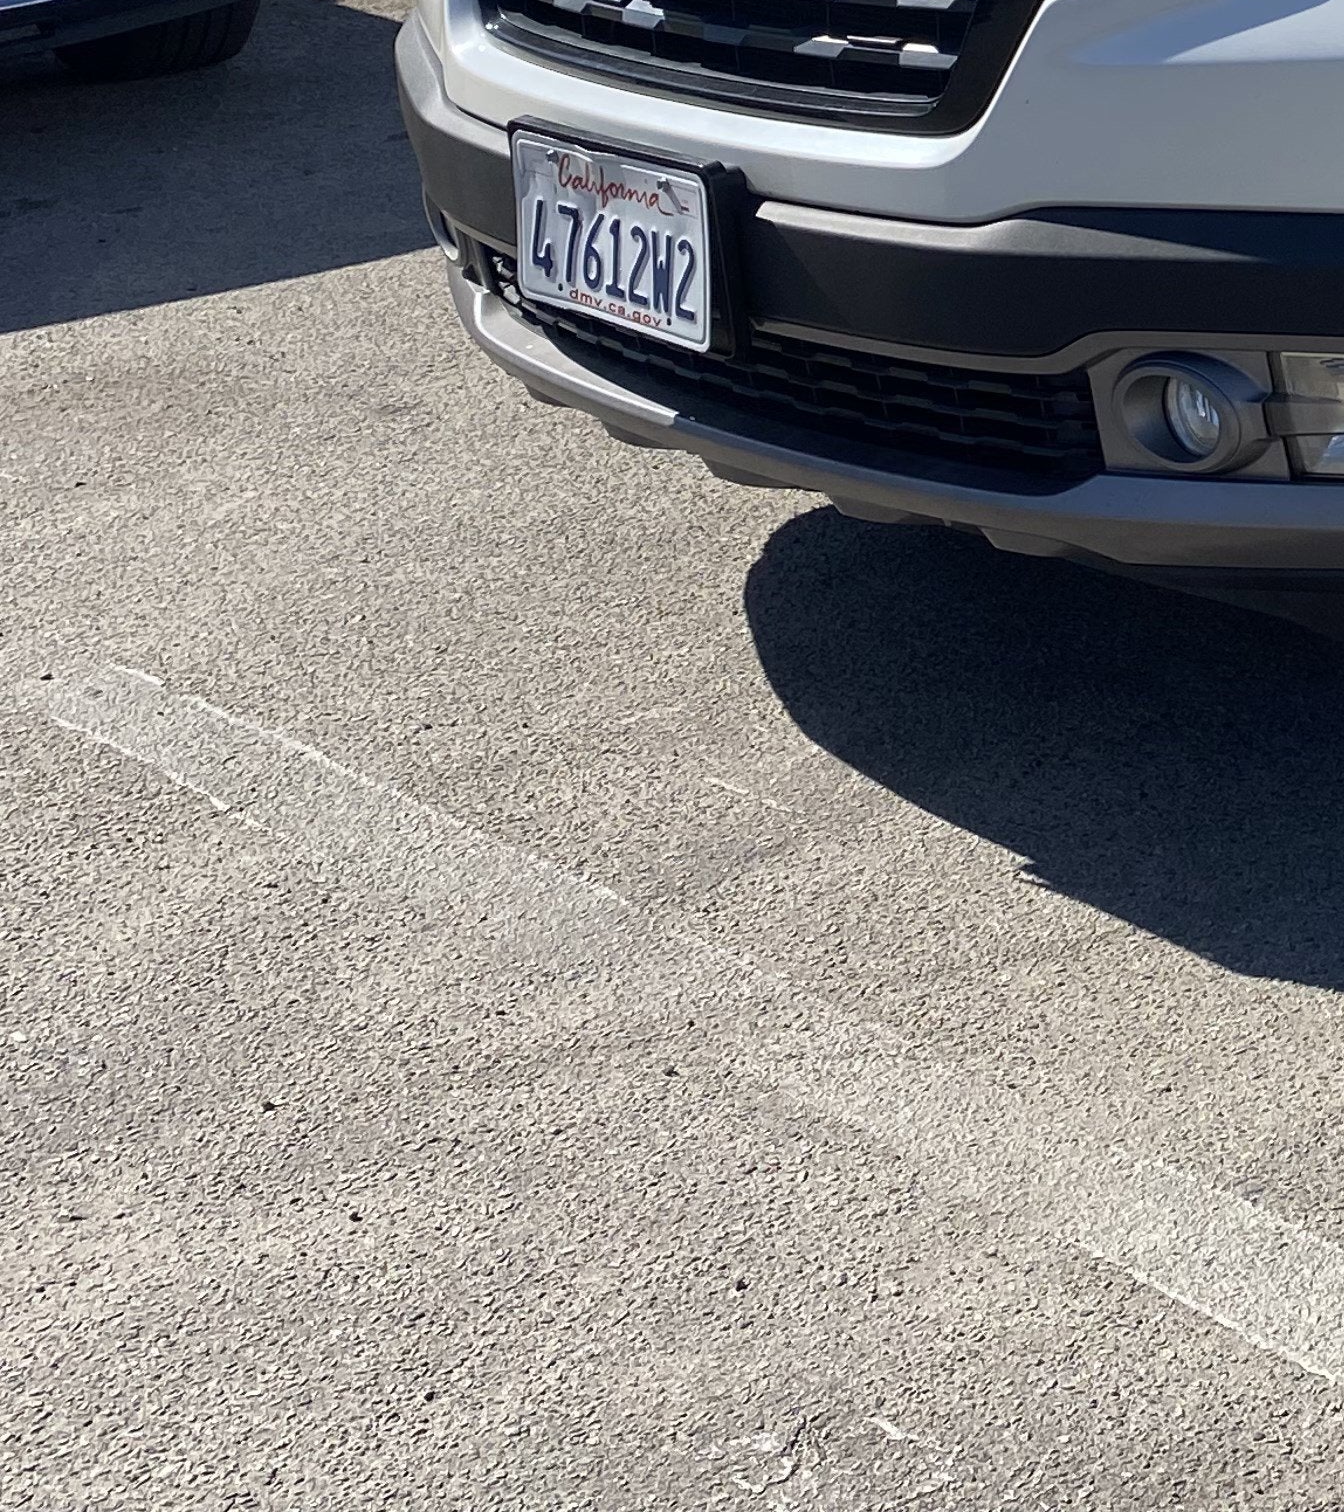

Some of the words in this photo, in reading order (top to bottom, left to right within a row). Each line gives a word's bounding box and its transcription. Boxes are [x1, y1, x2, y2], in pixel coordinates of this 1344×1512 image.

[557, 153, 674, 217] California
[531, 199, 695, 322] 47612W2
[569, 288, 663, 328] dmv.ca.gov
